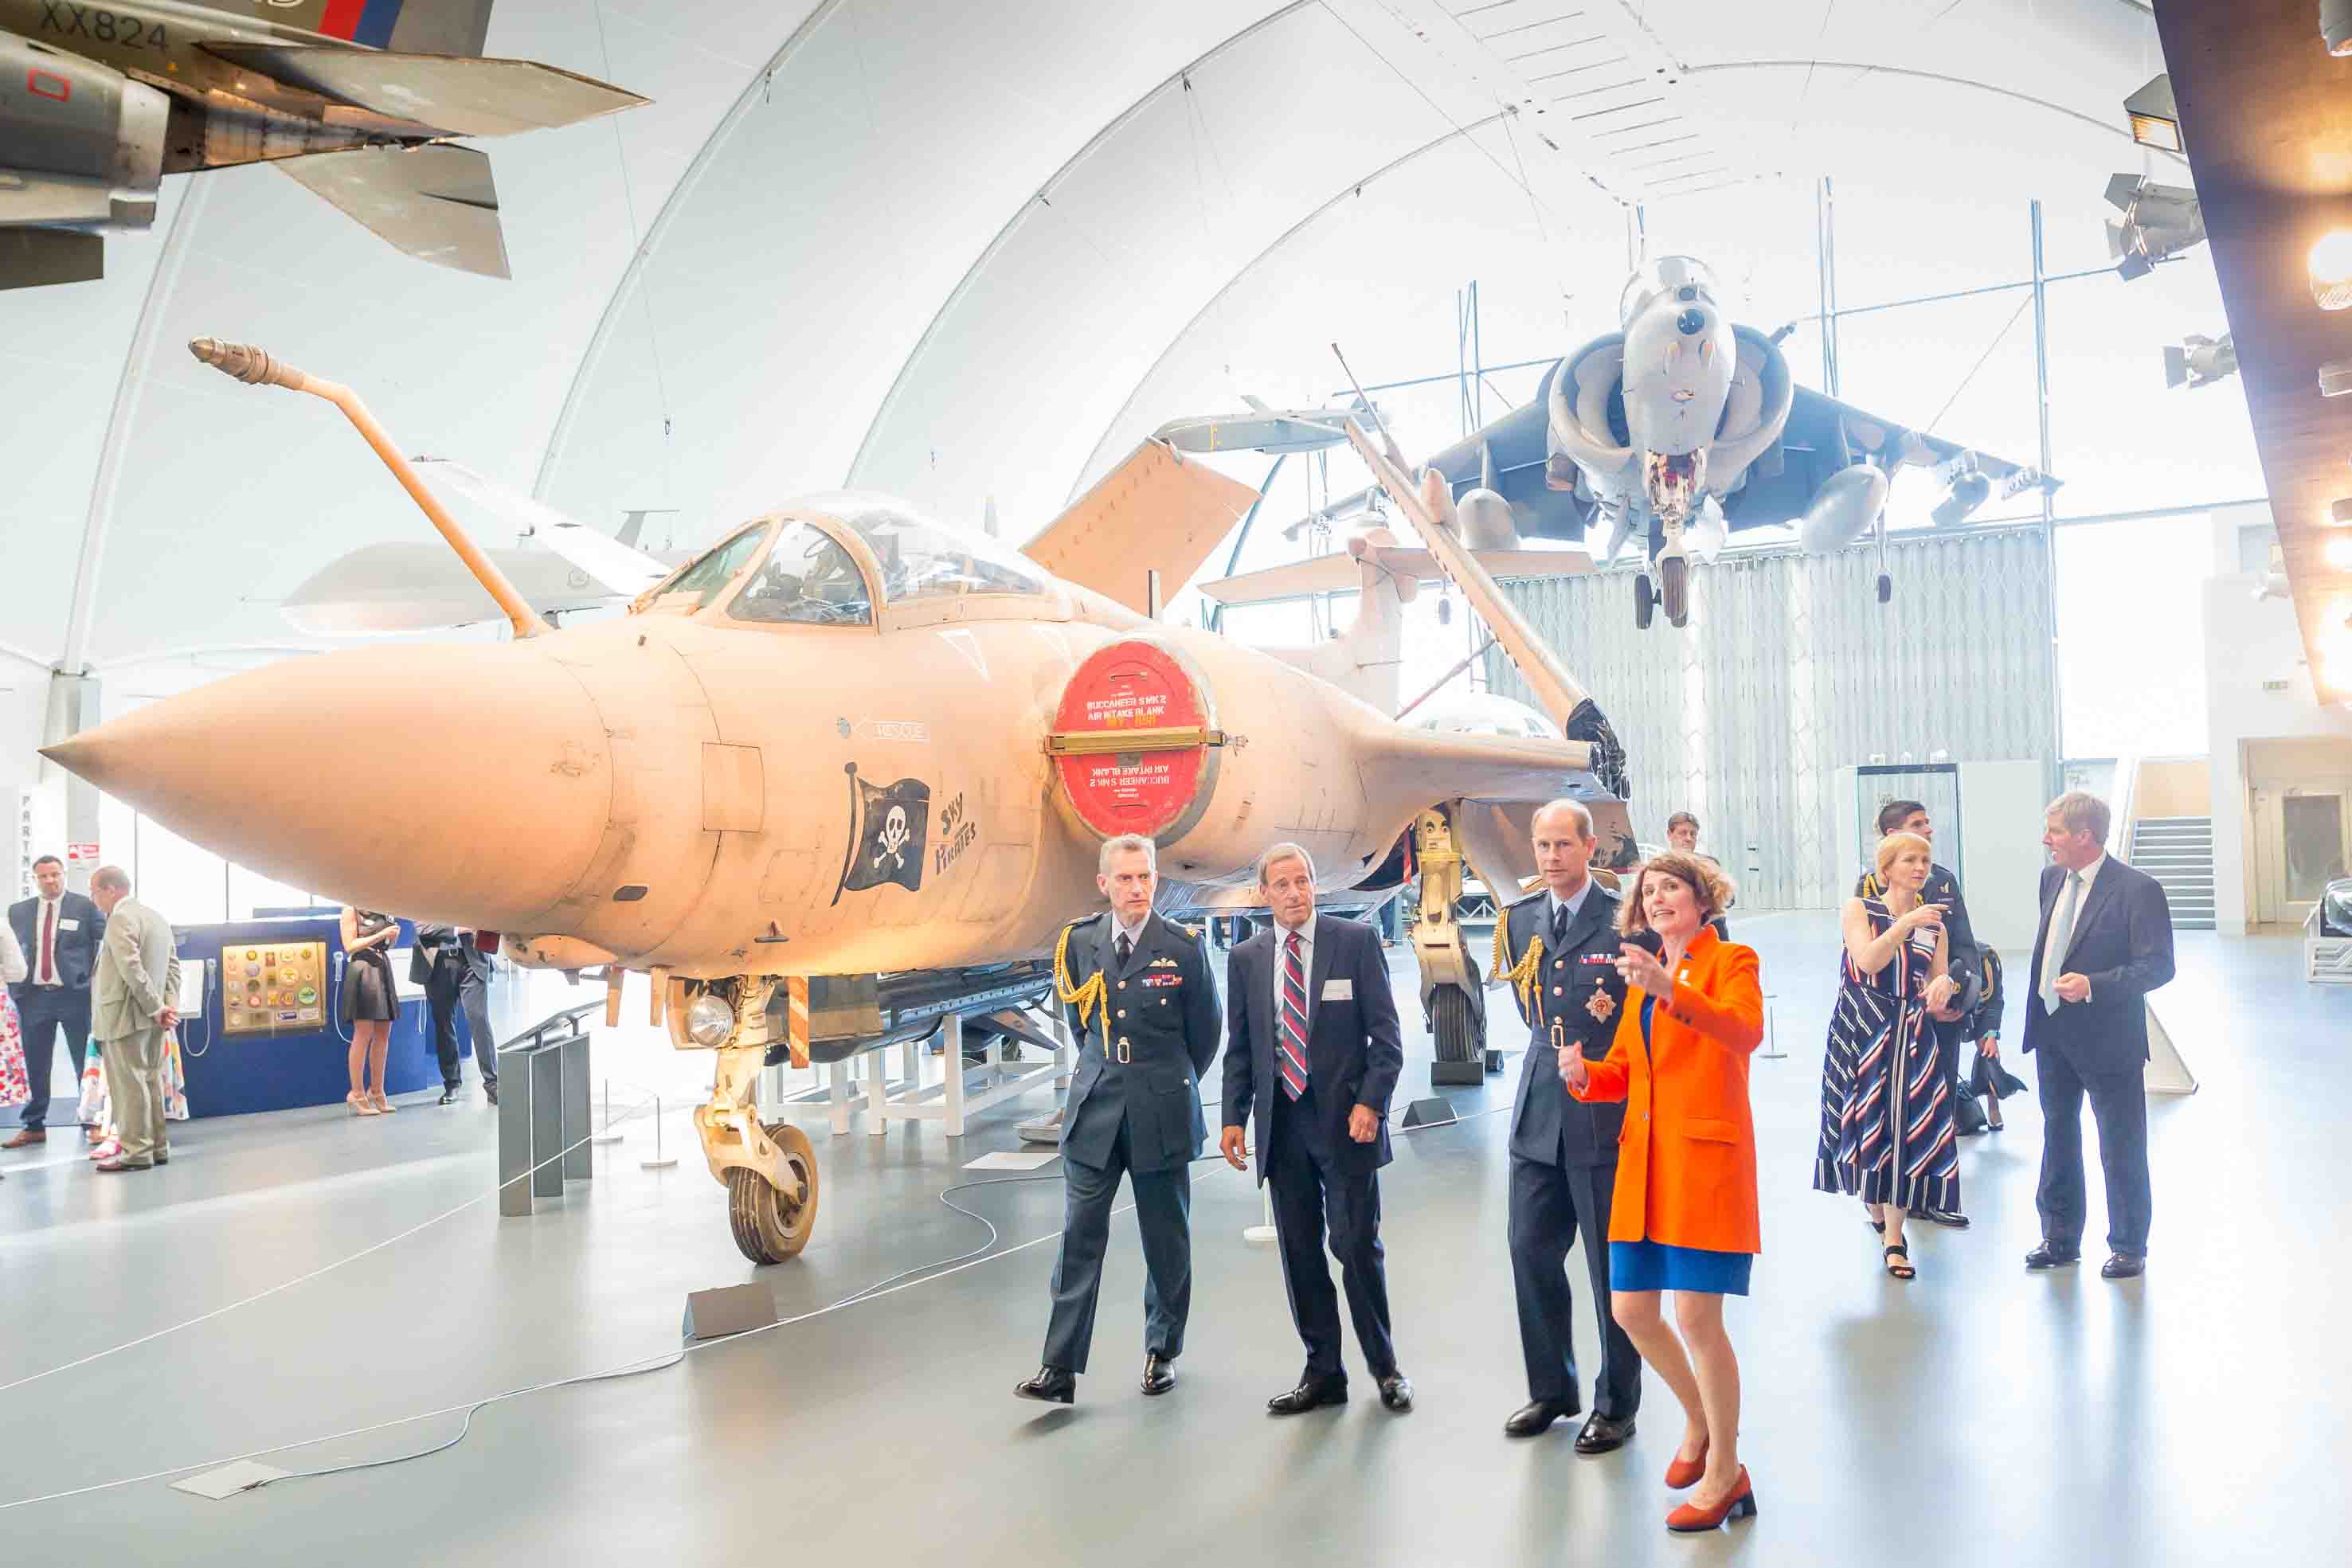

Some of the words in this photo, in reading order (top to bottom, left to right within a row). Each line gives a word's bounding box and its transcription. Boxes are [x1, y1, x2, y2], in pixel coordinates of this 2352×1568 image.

[40, 0, 170, 51] XX824
[1086, 698, 1137, 710] BUCCANEER
[1103, 709, 1134, 720] INTAKE
[1135, 706, 1164, 715] BLANK
[878, 725, 924, 738] RESCUE
[1092, 767, 1121, 776] BLANK
[1121, 765, 1153, 776] INTAKE
[1154, 764, 1169, 773] AIR
[1120, 776, 1170, 785] BUCCANEER
